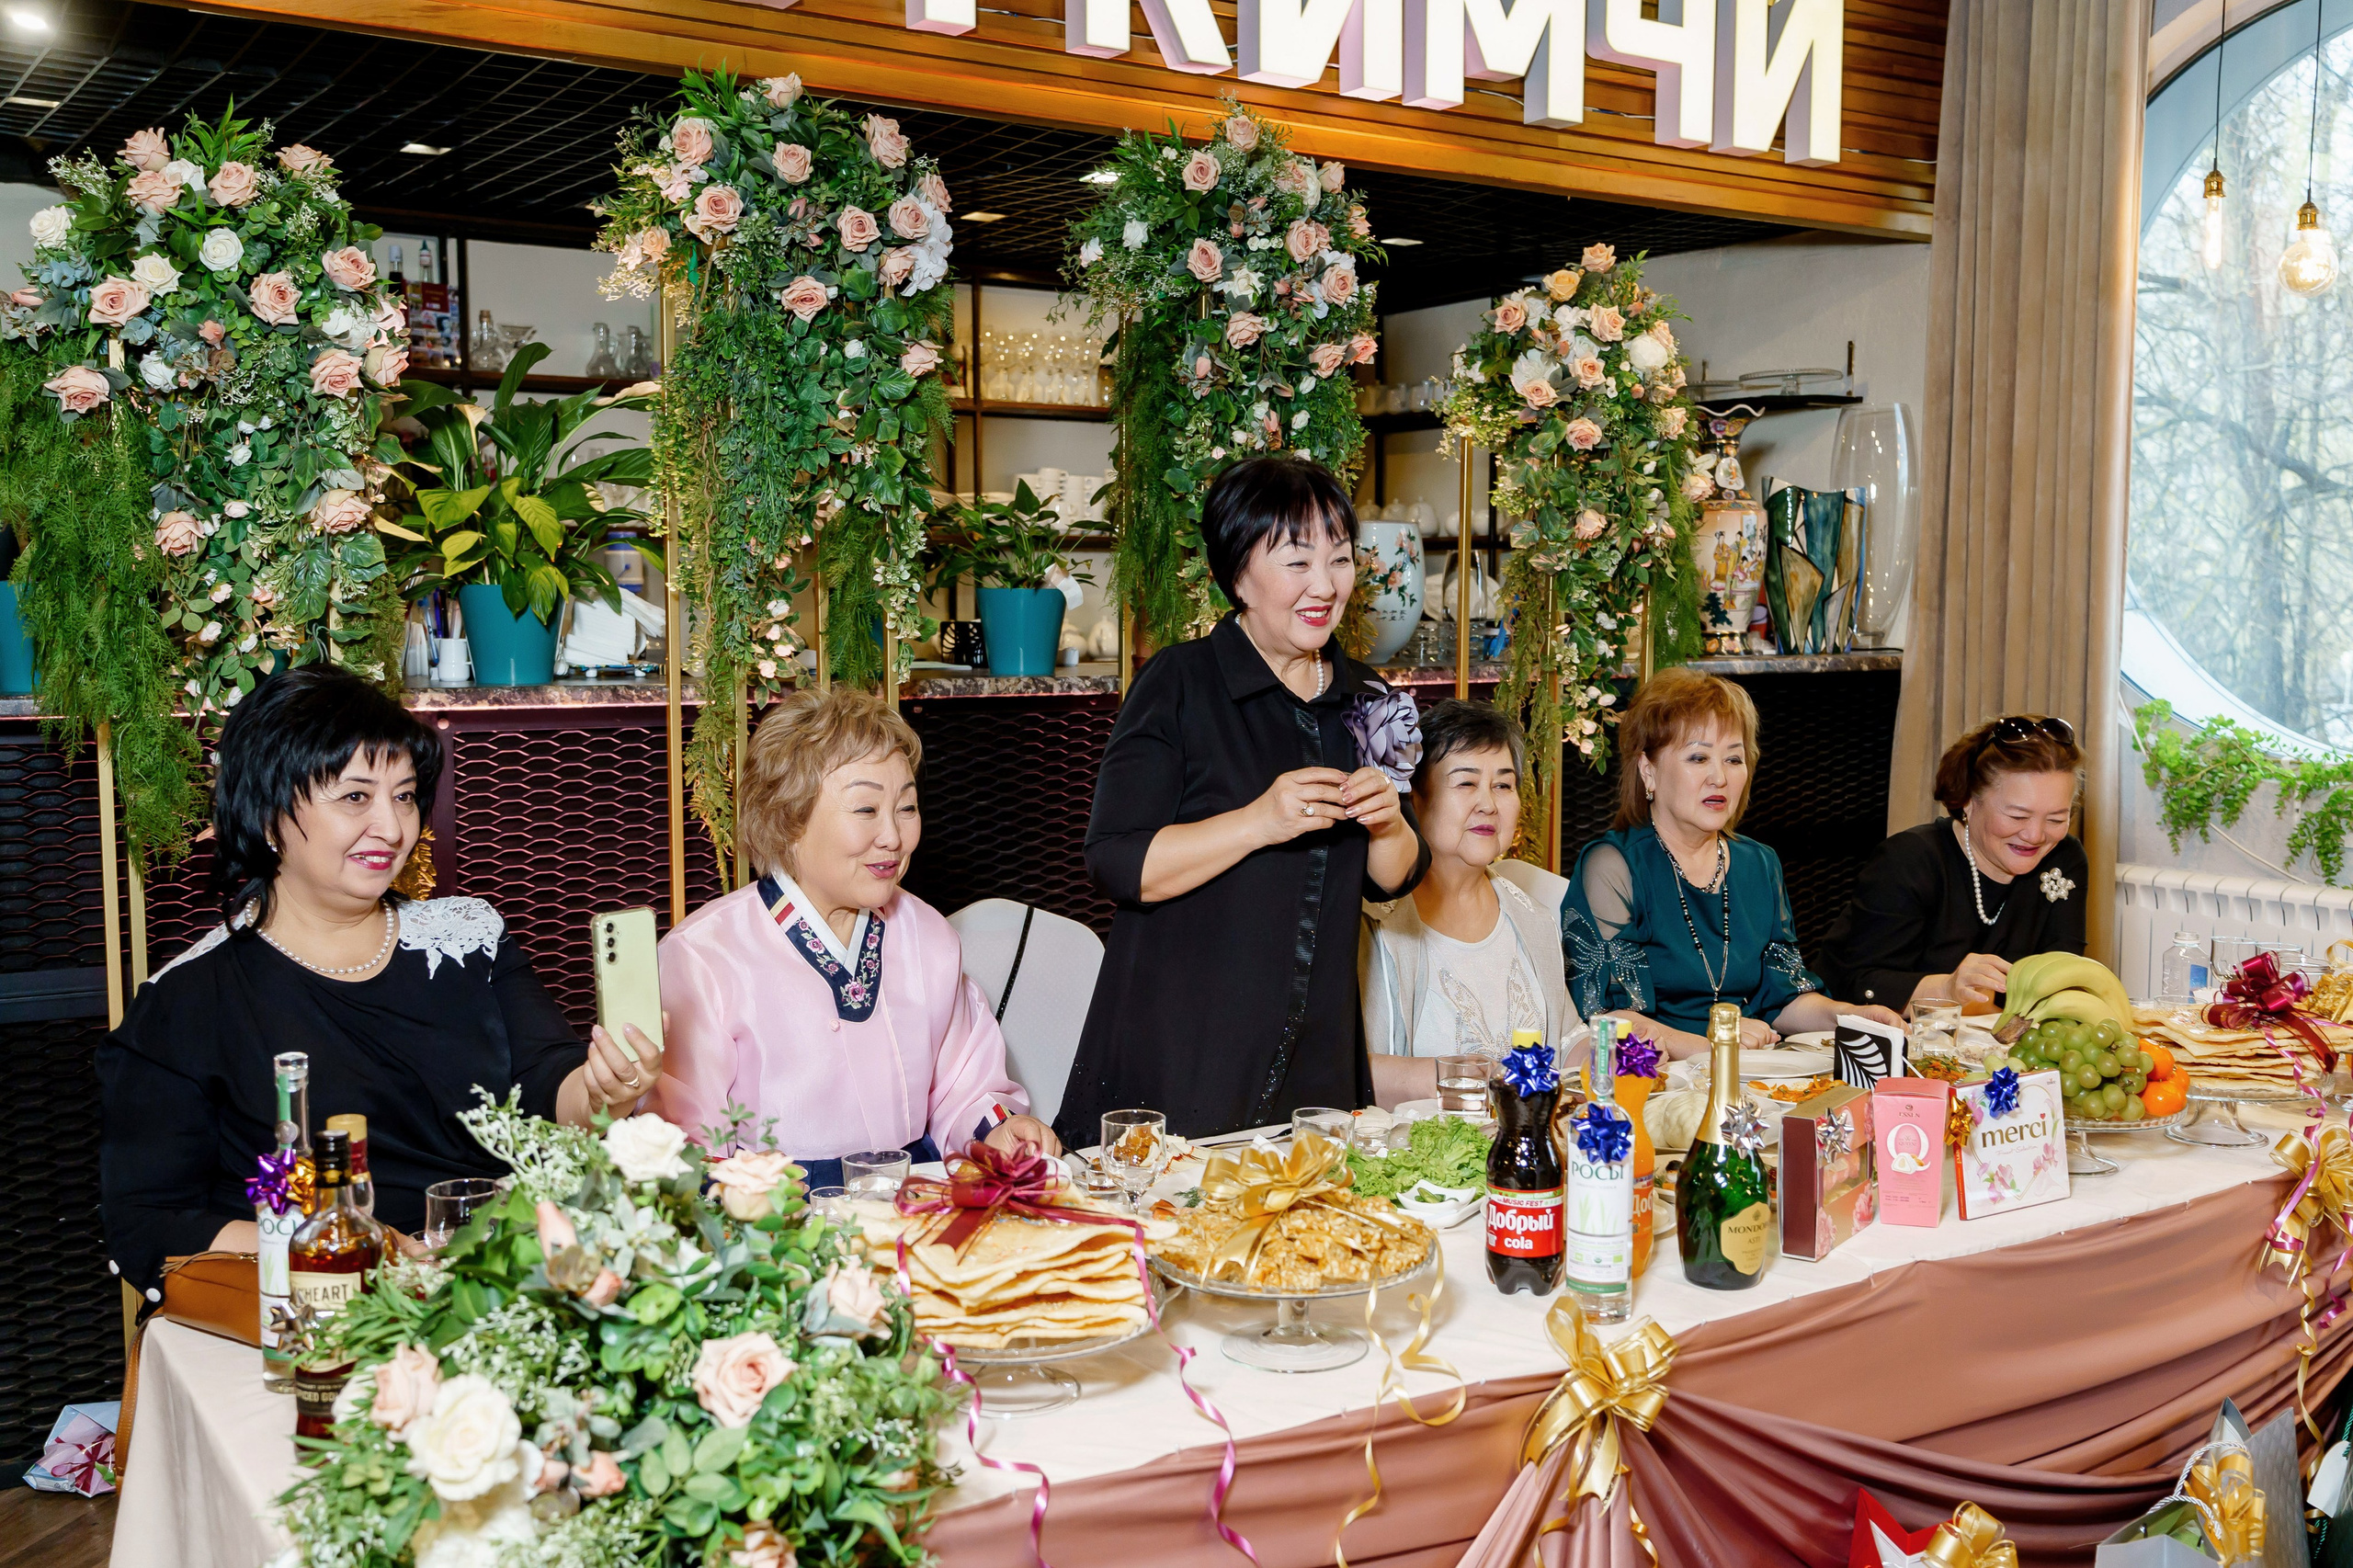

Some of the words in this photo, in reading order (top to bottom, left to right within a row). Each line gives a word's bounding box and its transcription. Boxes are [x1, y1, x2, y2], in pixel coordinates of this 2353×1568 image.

[1981, 1112, 2048, 1148] merci
[1571, 1160, 1623, 1181] РОСЫ
[1503, 1197, 1524, 1206] MUSIC
[1488, 1203, 1554, 1235] Добрый
[1504, 1235, 1533, 1250] cola
